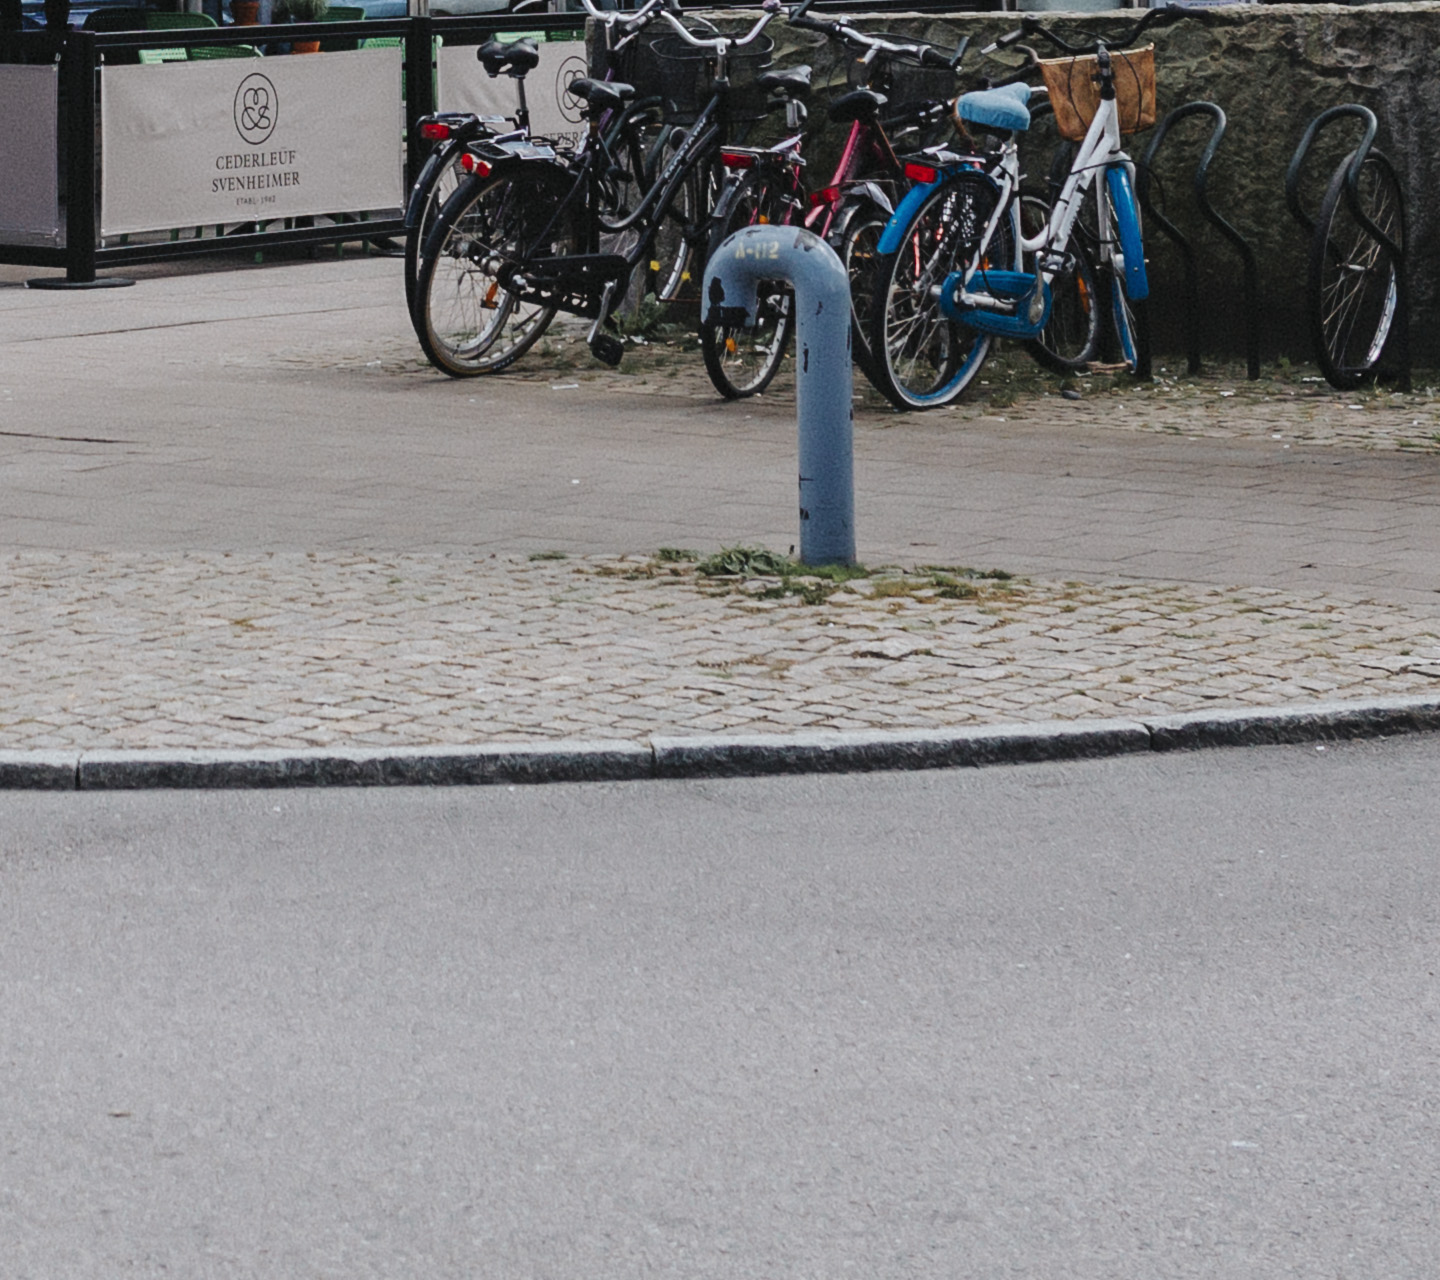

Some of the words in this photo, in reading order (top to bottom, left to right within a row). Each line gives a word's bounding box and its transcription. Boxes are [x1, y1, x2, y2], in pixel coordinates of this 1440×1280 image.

[215, 146, 297, 171] CEDERLEÜF
[211, 171, 301, 193] SVENHEIMER
[734, 240, 780, 260] A-112
